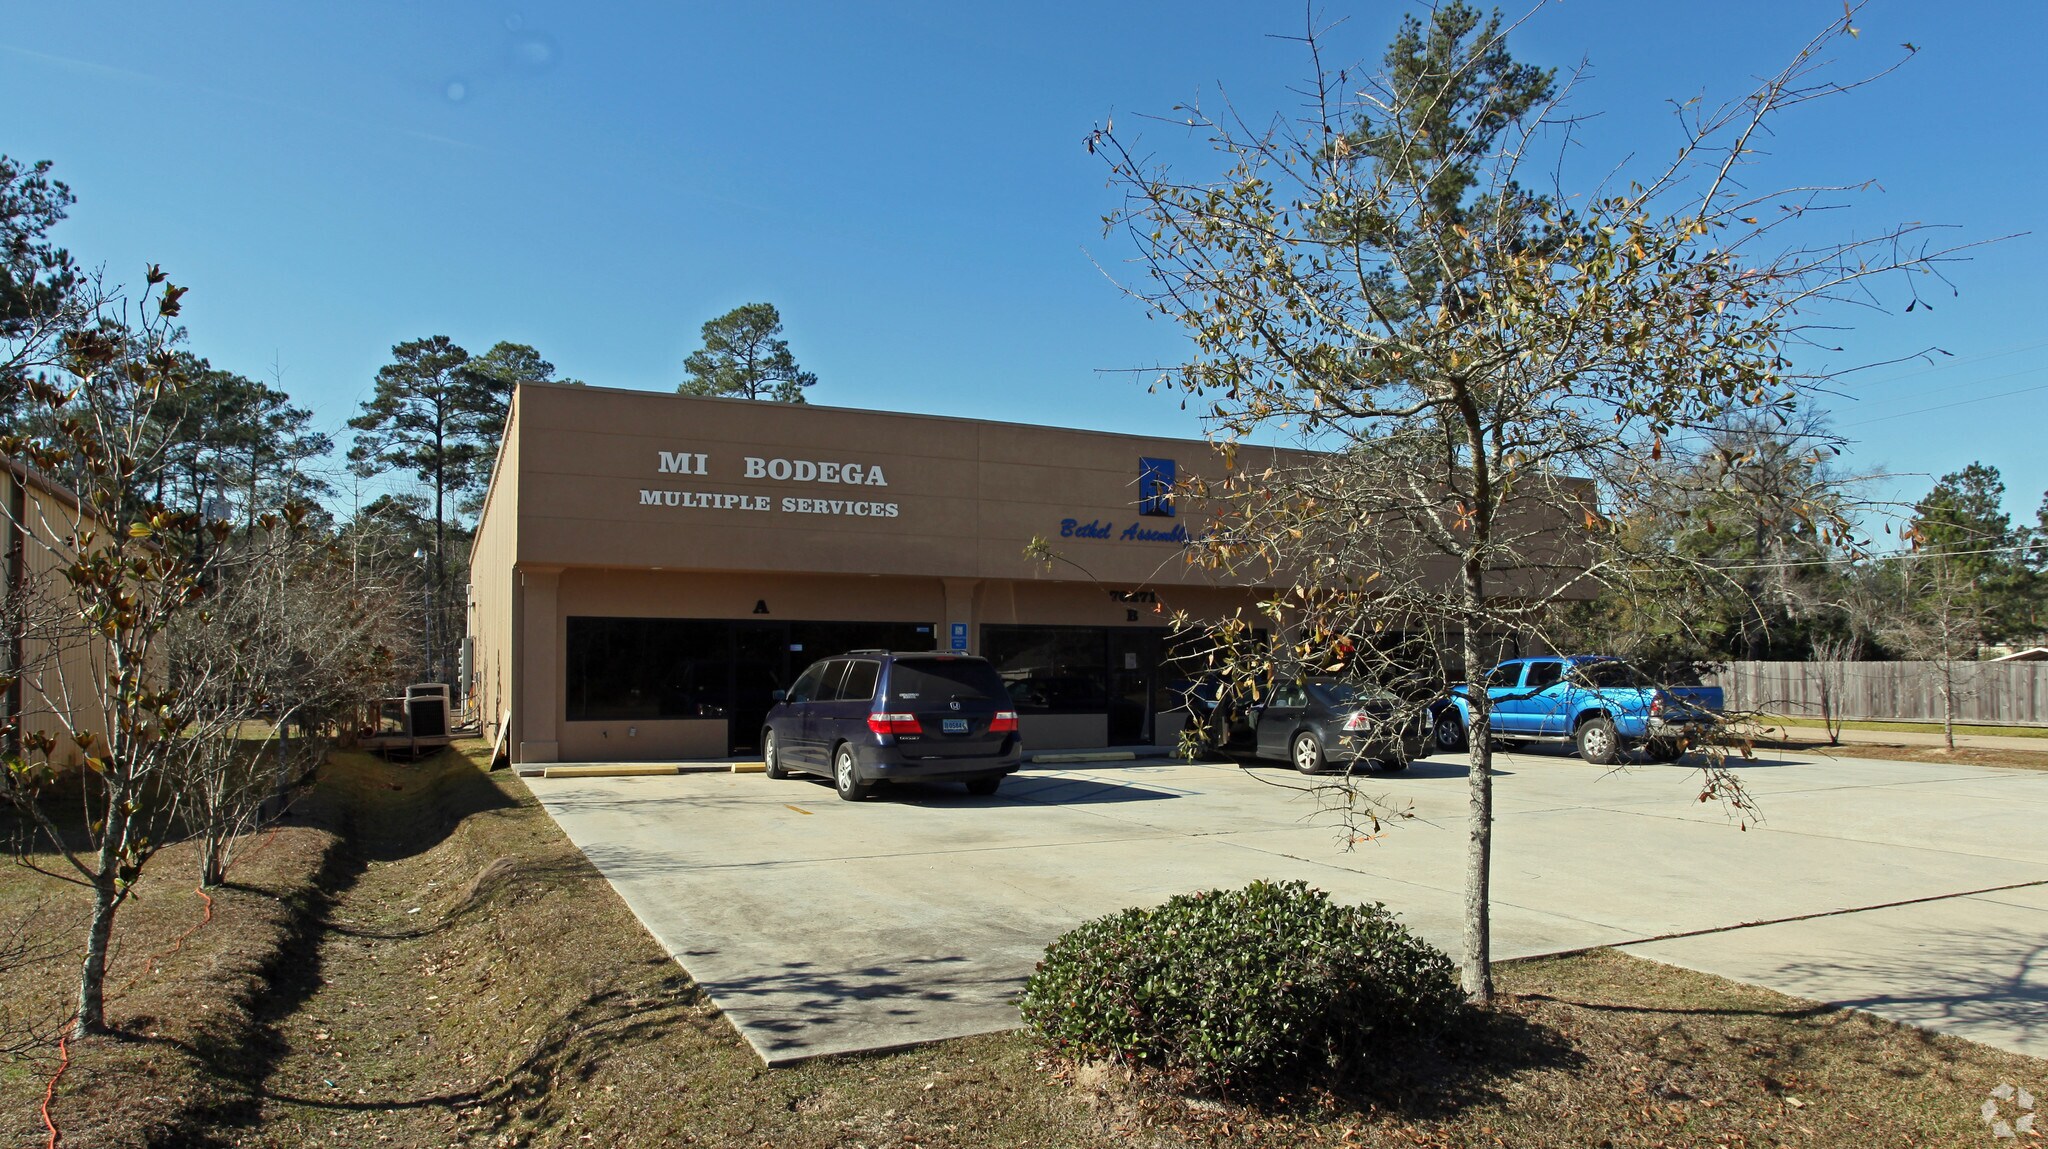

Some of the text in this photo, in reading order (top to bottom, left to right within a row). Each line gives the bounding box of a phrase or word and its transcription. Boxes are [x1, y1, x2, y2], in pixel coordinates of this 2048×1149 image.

[658, 451, 888, 487] MI BODEGA
[639, 489, 899, 518] MULTIPLE SERVICES
[1060, 518, 1112, 540] Bethel
[753, 600, 770, 614] A
[1127, 609, 1138, 622] B
